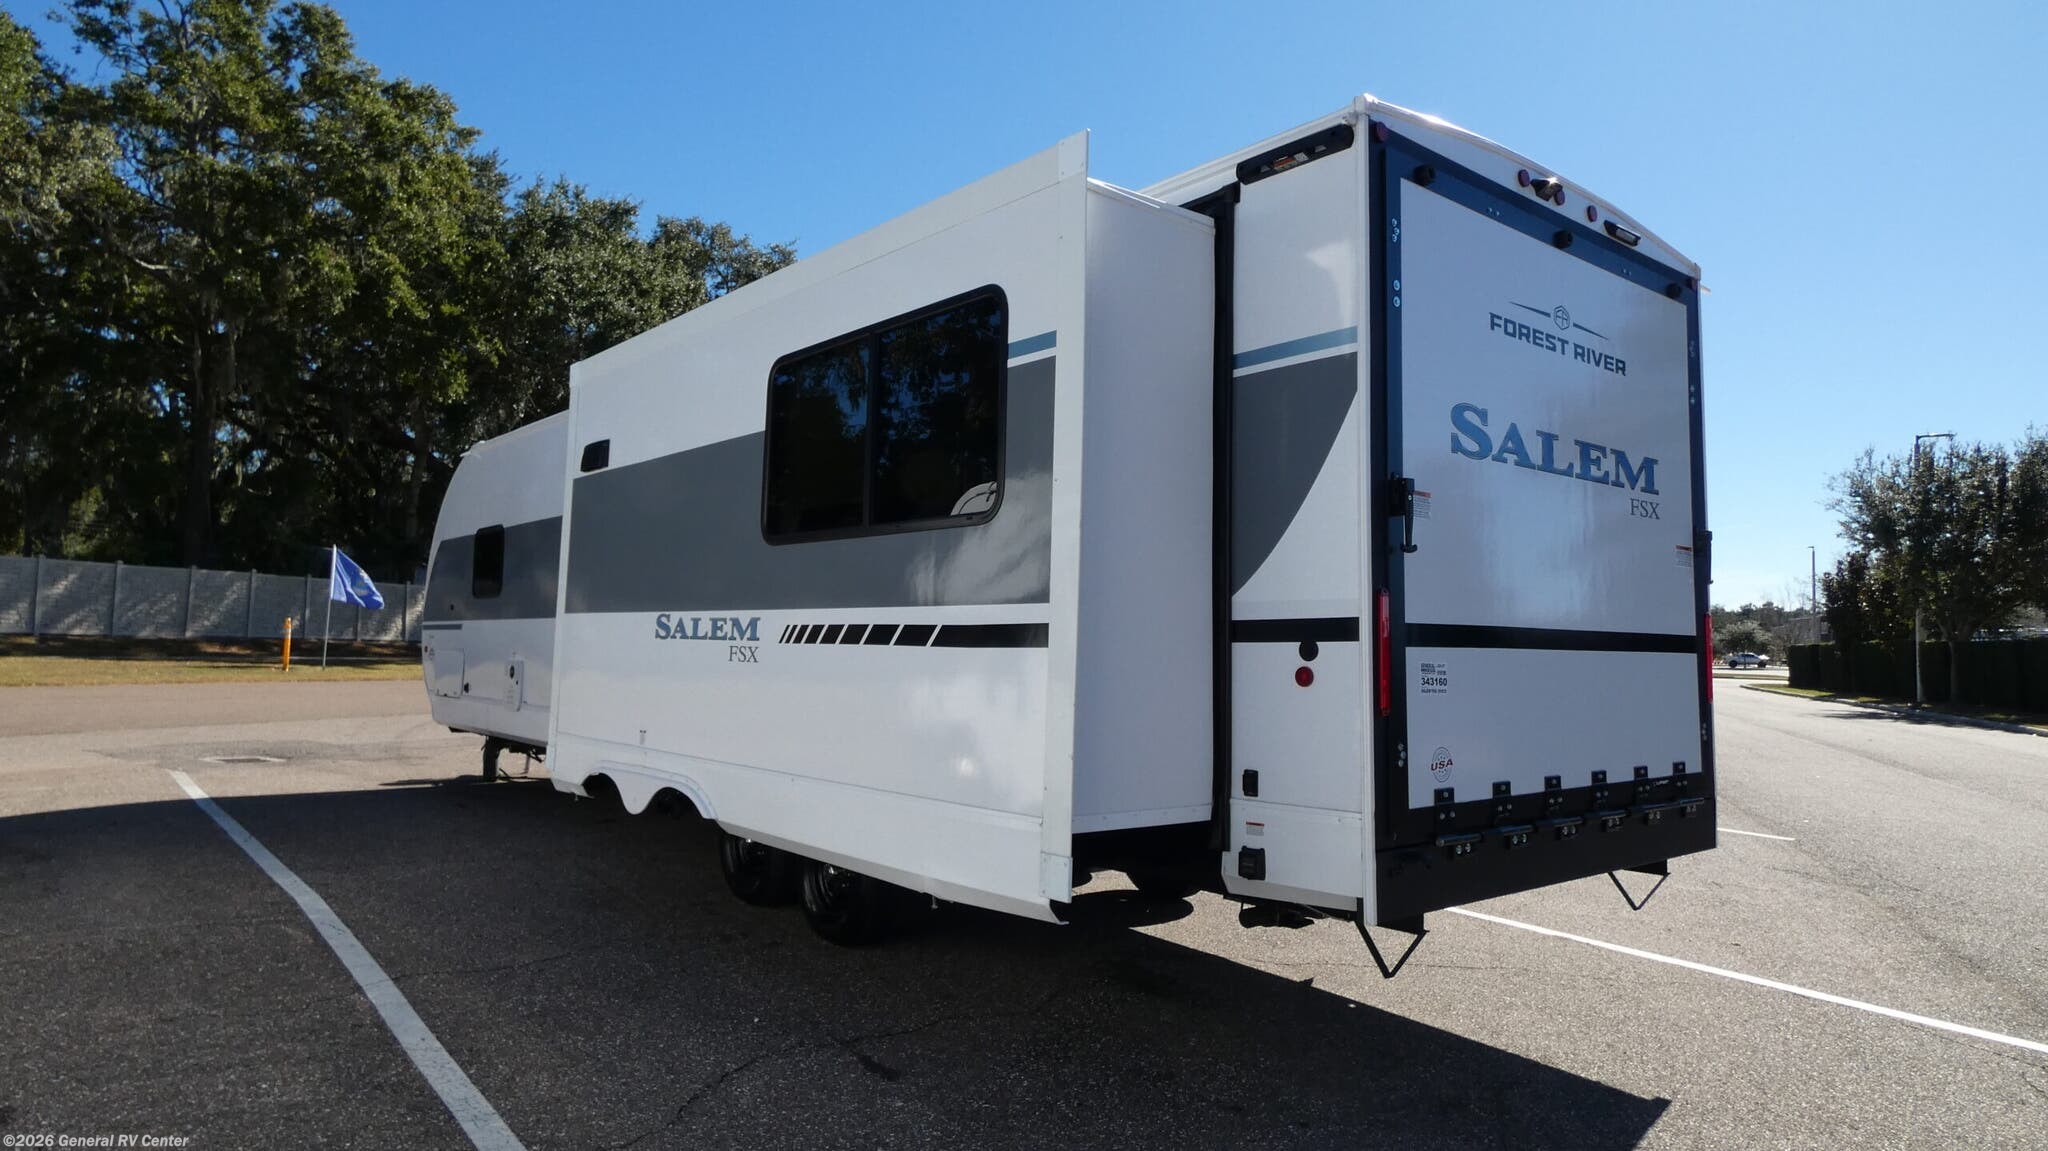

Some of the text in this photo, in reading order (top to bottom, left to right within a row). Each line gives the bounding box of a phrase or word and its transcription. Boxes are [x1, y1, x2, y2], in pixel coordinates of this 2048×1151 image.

[1488, 311, 1627, 377] FOREST RIVER
[1450, 402, 1660, 496] SALEM
[1630, 498, 1661, 520] FSX
[655, 613, 761, 642] SALEM
[728, 645, 759, 663] FSX
[1421, 677, 1448, 687] 343160
[1431, 758, 1453, 771] USA
